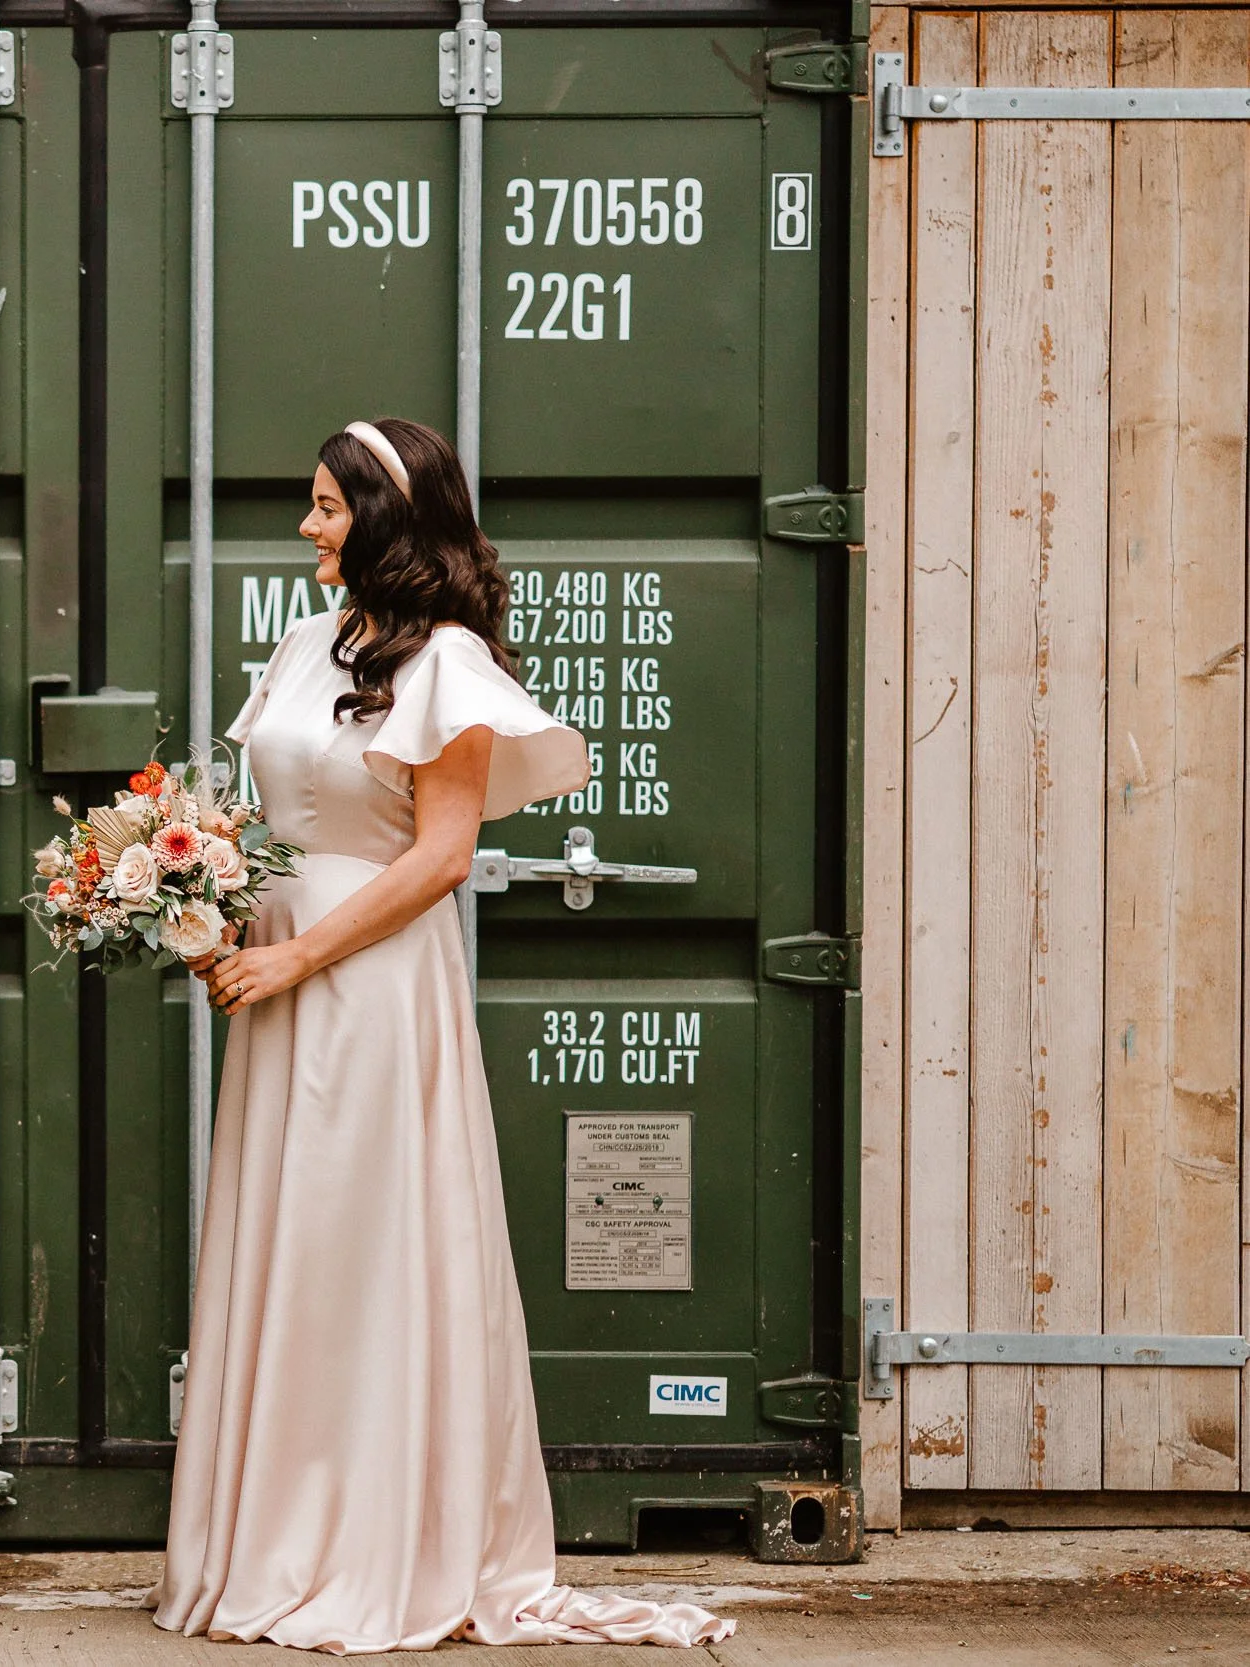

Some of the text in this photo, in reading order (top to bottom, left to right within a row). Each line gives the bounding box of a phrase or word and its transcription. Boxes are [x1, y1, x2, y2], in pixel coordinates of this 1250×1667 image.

[292, 177, 807, 249] PSSU 370558 8
[505, 272, 631, 341] 22G1
[509, 571, 661, 608] 30,480 KG
[508, 608, 673, 646] 67,200 LBS
[525, 656, 659, 693] 2,015 KG
[621, 696, 671, 731] LBS
[619, 743, 657, 777] KG
[619, 781, 669, 816] LBS
[543, 1010, 700, 1047] 33.2 CU.M
[527, 1048, 700, 1086] 1,170 CU.FT
[578, 1123, 680, 1131] APPROVED FOR TRANSPORT
[612, 1182, 646, 1191] CIMC
[585, 1220, 672, 1228] CSC SAFETY APPROVAL
[656, 1384, 720, 1402] CIMC
